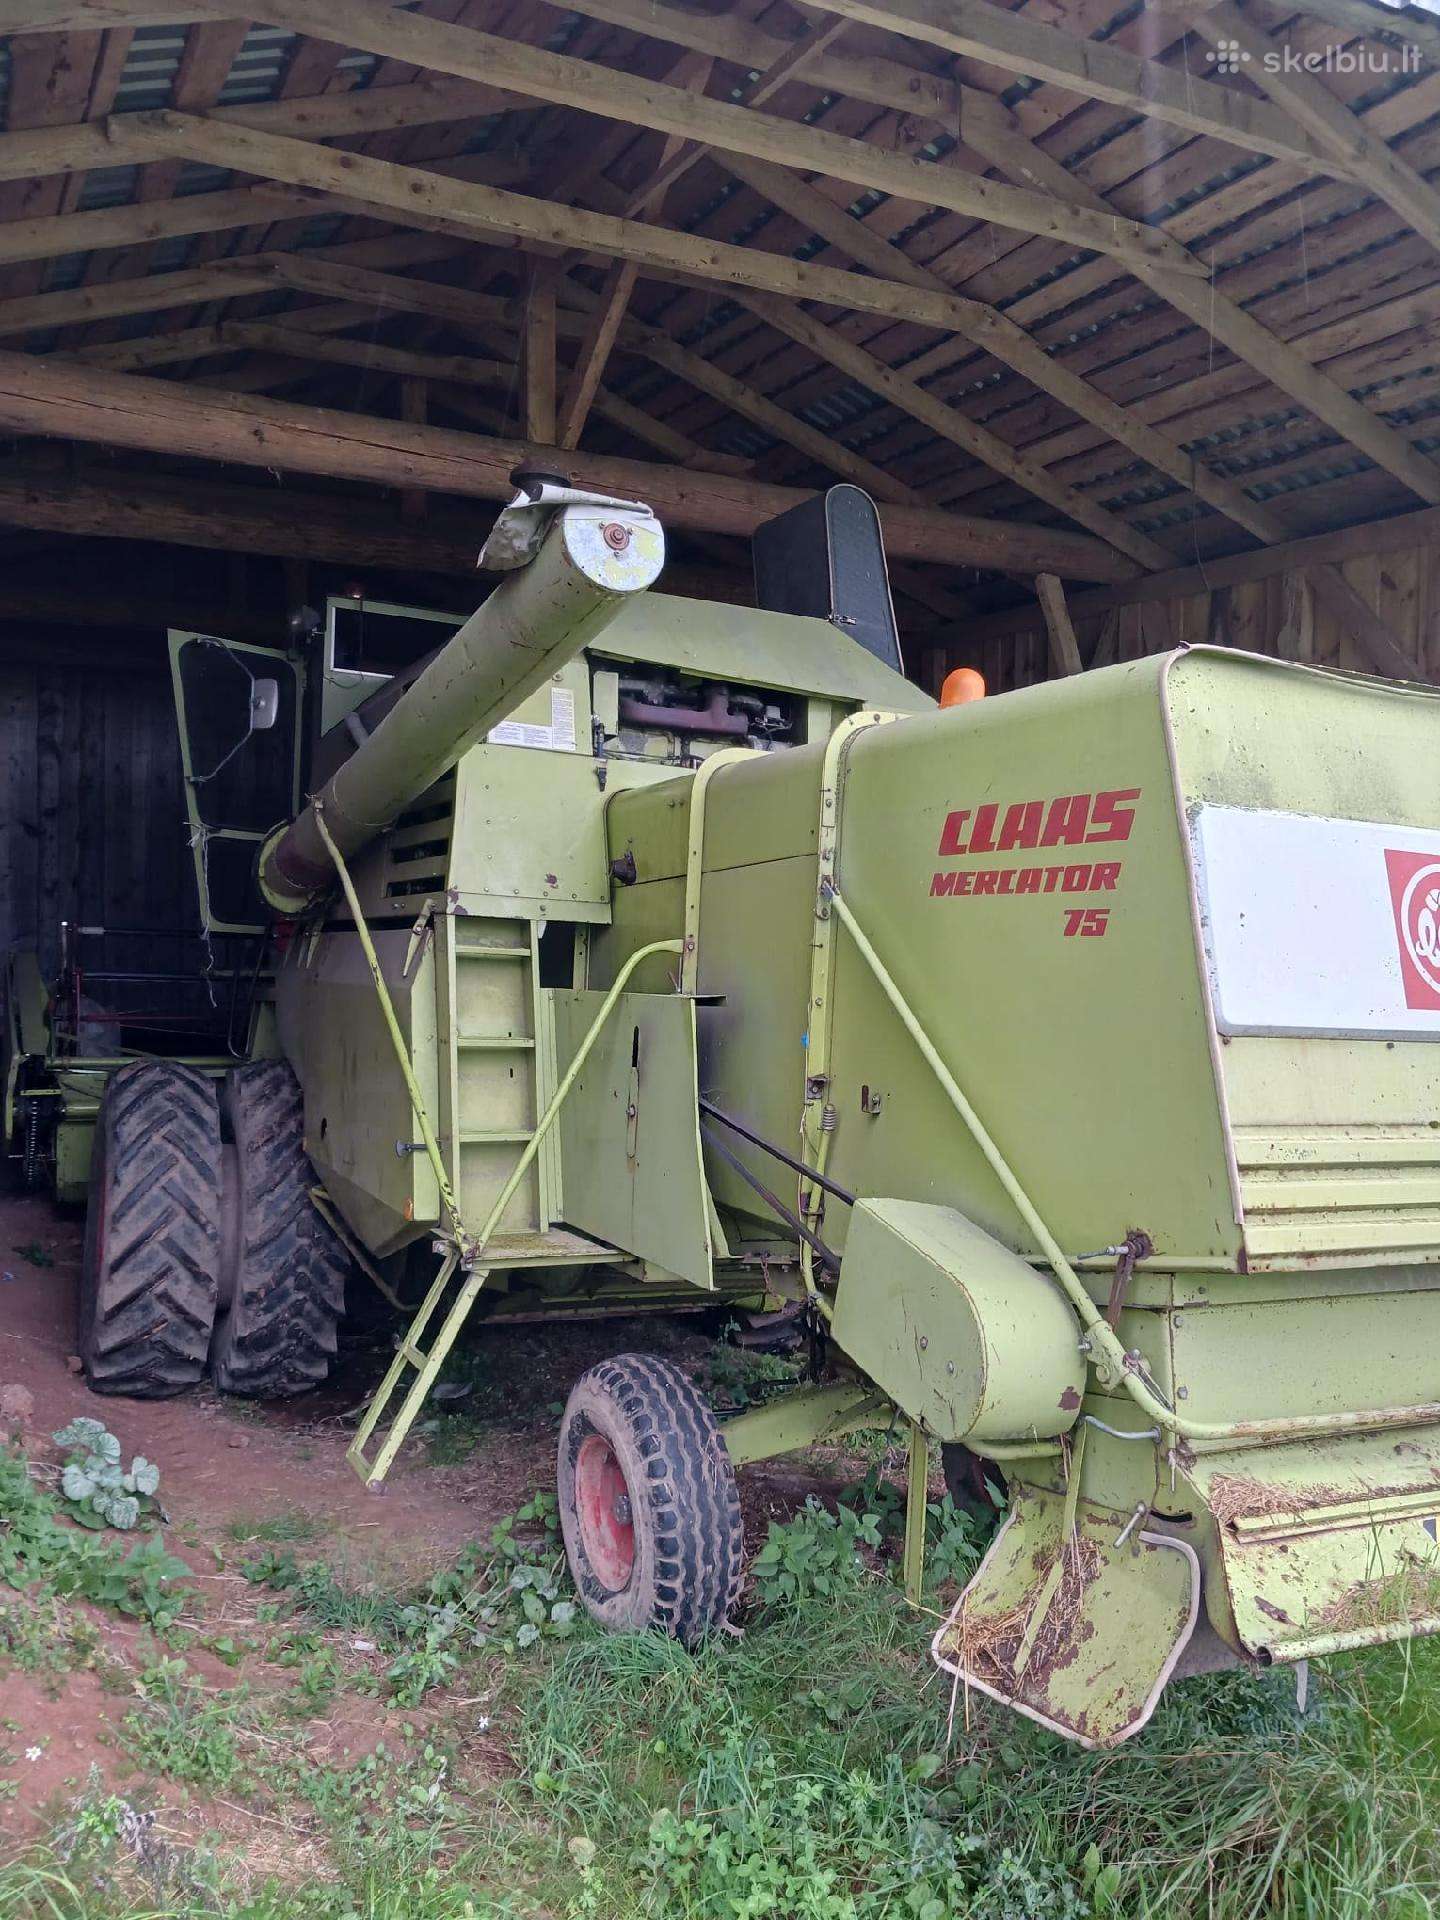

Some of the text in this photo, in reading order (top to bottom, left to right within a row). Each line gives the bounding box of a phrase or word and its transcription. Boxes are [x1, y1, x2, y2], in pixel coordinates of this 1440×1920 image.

[938, 788, 1142, 856] CLAAS
[929, 862, 1122, 897] MERCATOR
[1063, 908, 1111, 937] 75
